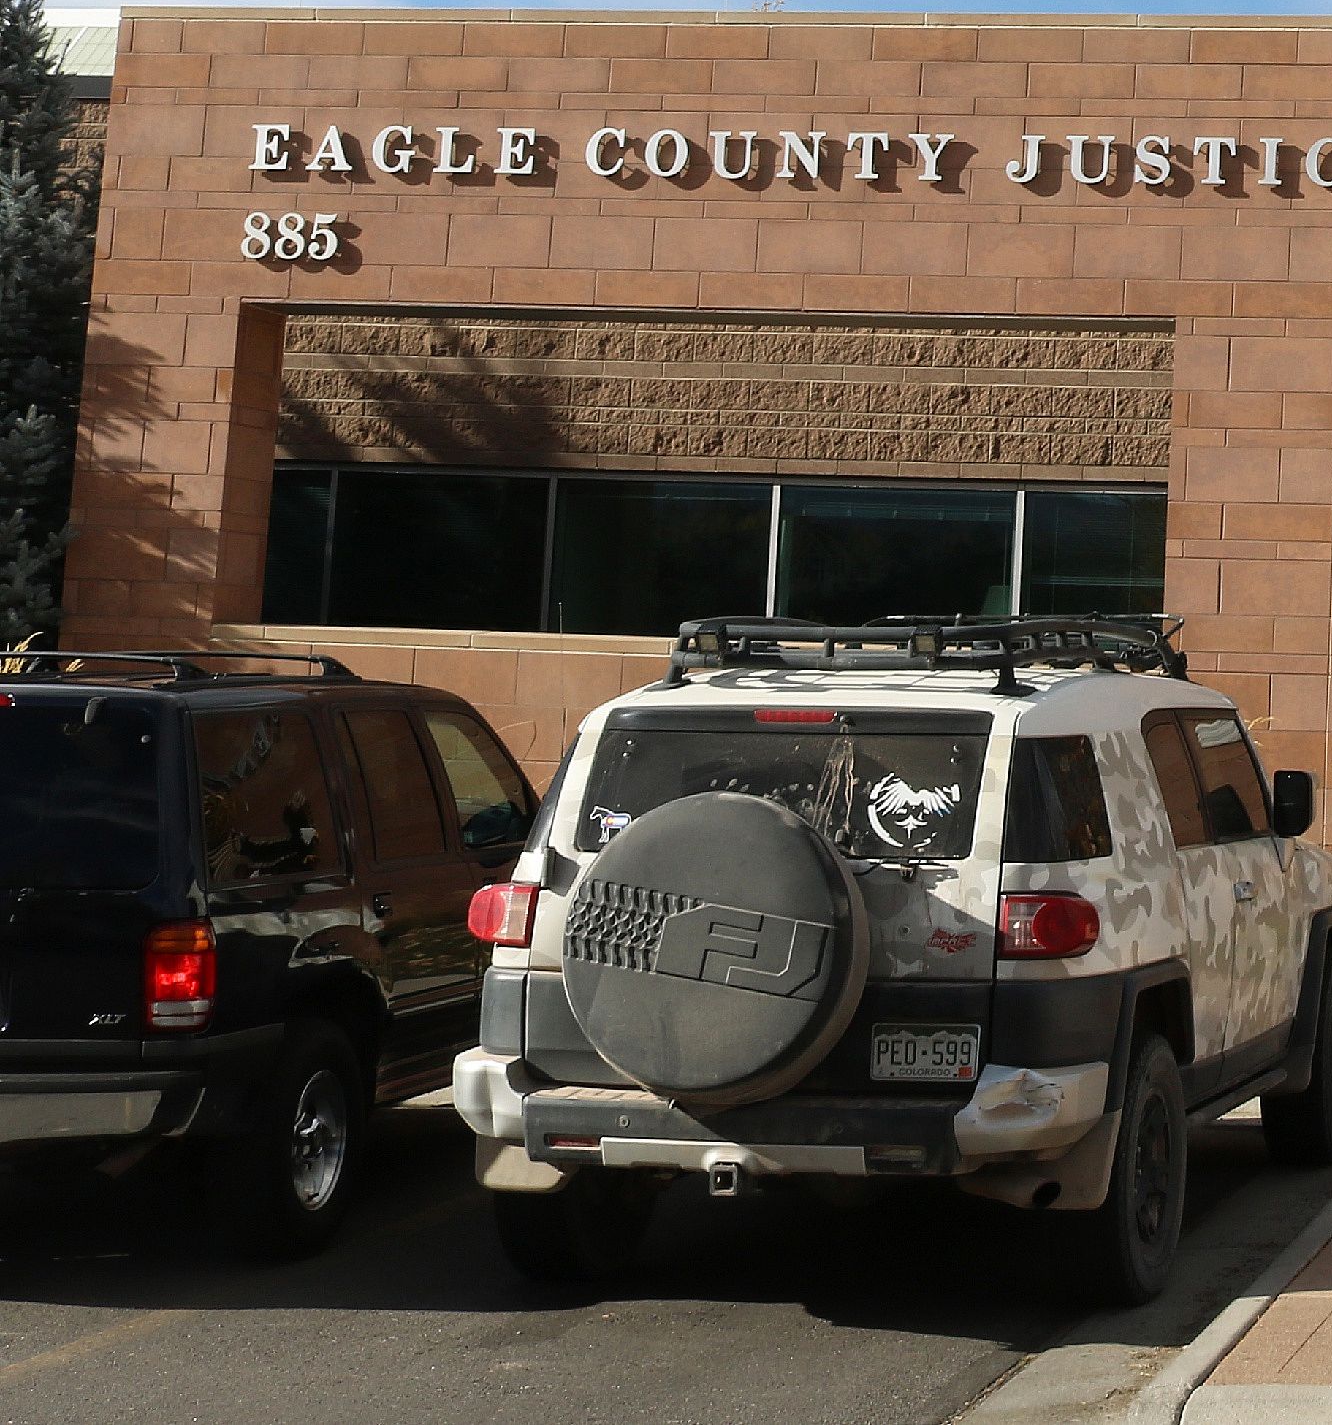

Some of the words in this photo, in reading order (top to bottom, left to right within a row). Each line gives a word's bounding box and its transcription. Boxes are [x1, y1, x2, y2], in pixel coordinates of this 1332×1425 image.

[248, 124, 538, 175] EAGLE
[584, 126, 957, 182] COUNTY
[239, 211, 340, 262] 885
[88, 1013, 128, 1025] XLT
[898, 1067, 952, 1077] COLORADO
